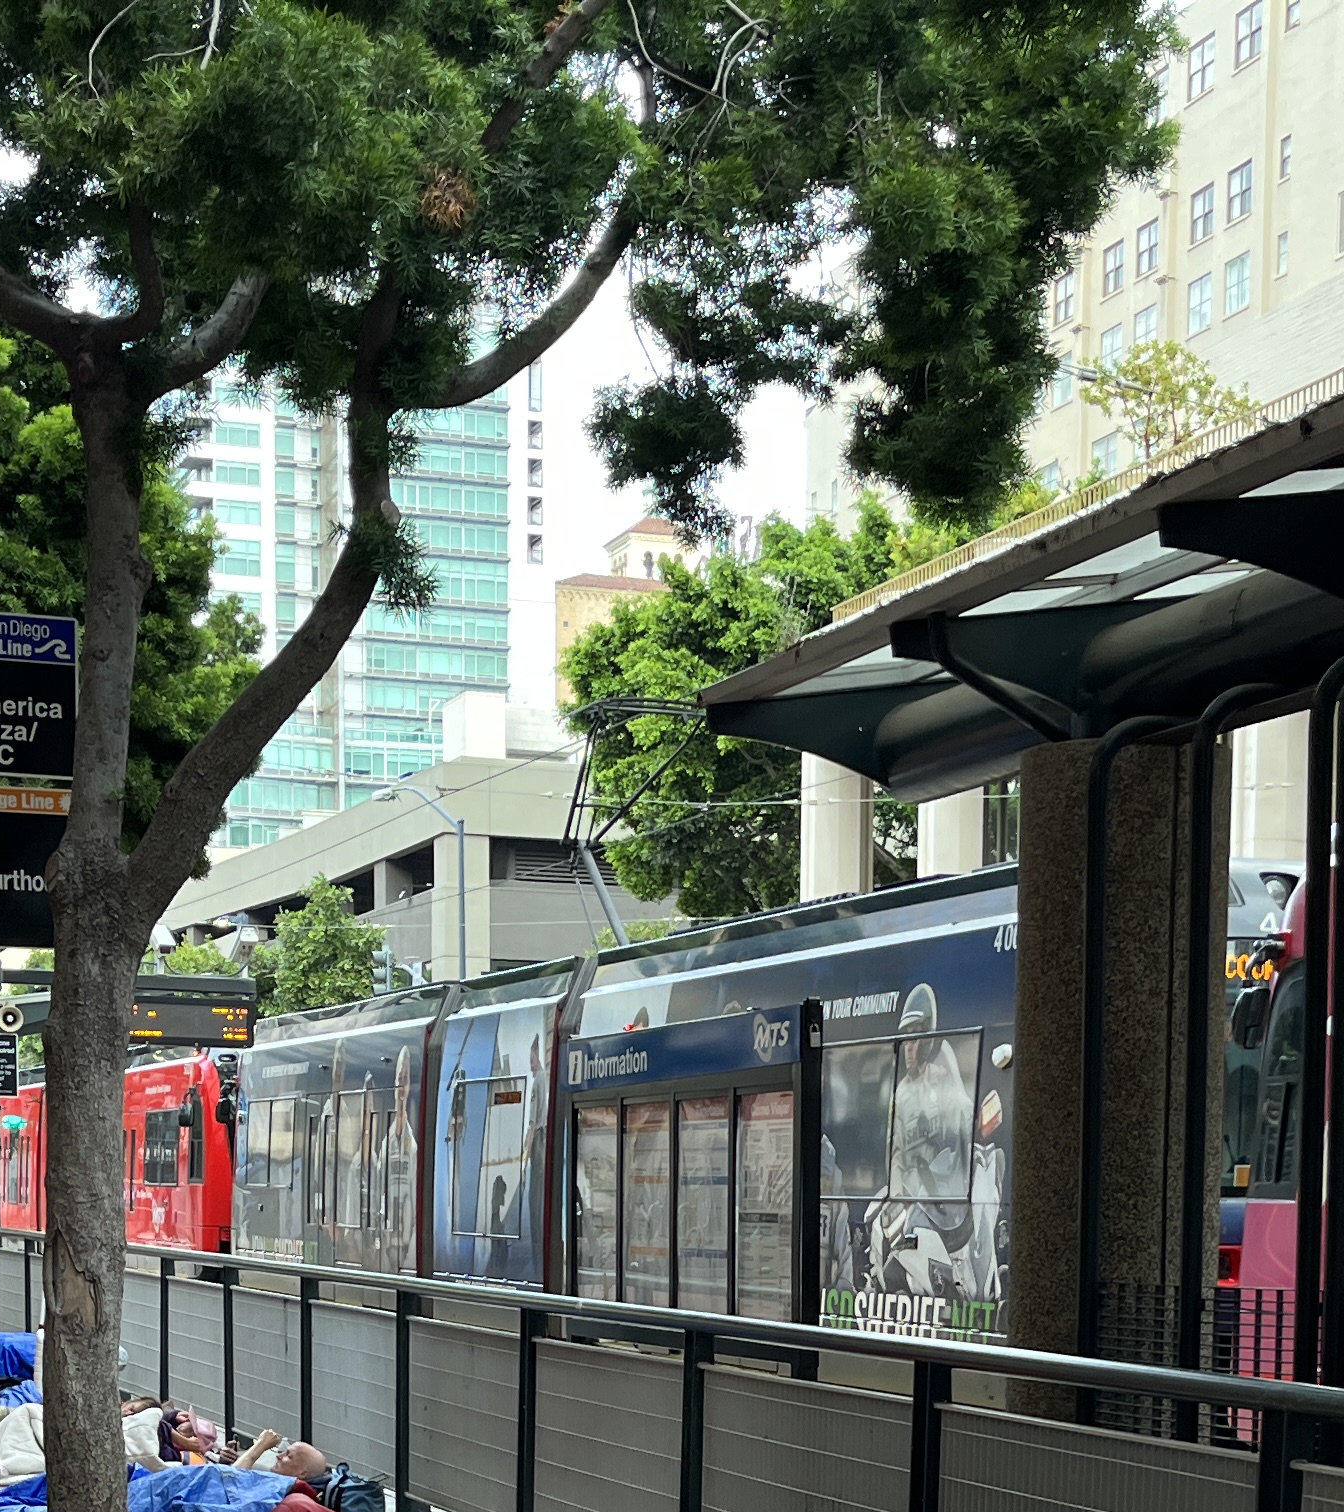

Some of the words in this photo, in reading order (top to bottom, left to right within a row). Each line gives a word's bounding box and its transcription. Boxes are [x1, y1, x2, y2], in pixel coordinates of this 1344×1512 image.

[10, 620, 50, 642] Diego
[21, 793, 54, 809] Line
[852, 991, 900, 1016] COMMUNITY
[754, 1020, 790, 1050] MTS
[584, 1047, 648, 1081] Information
